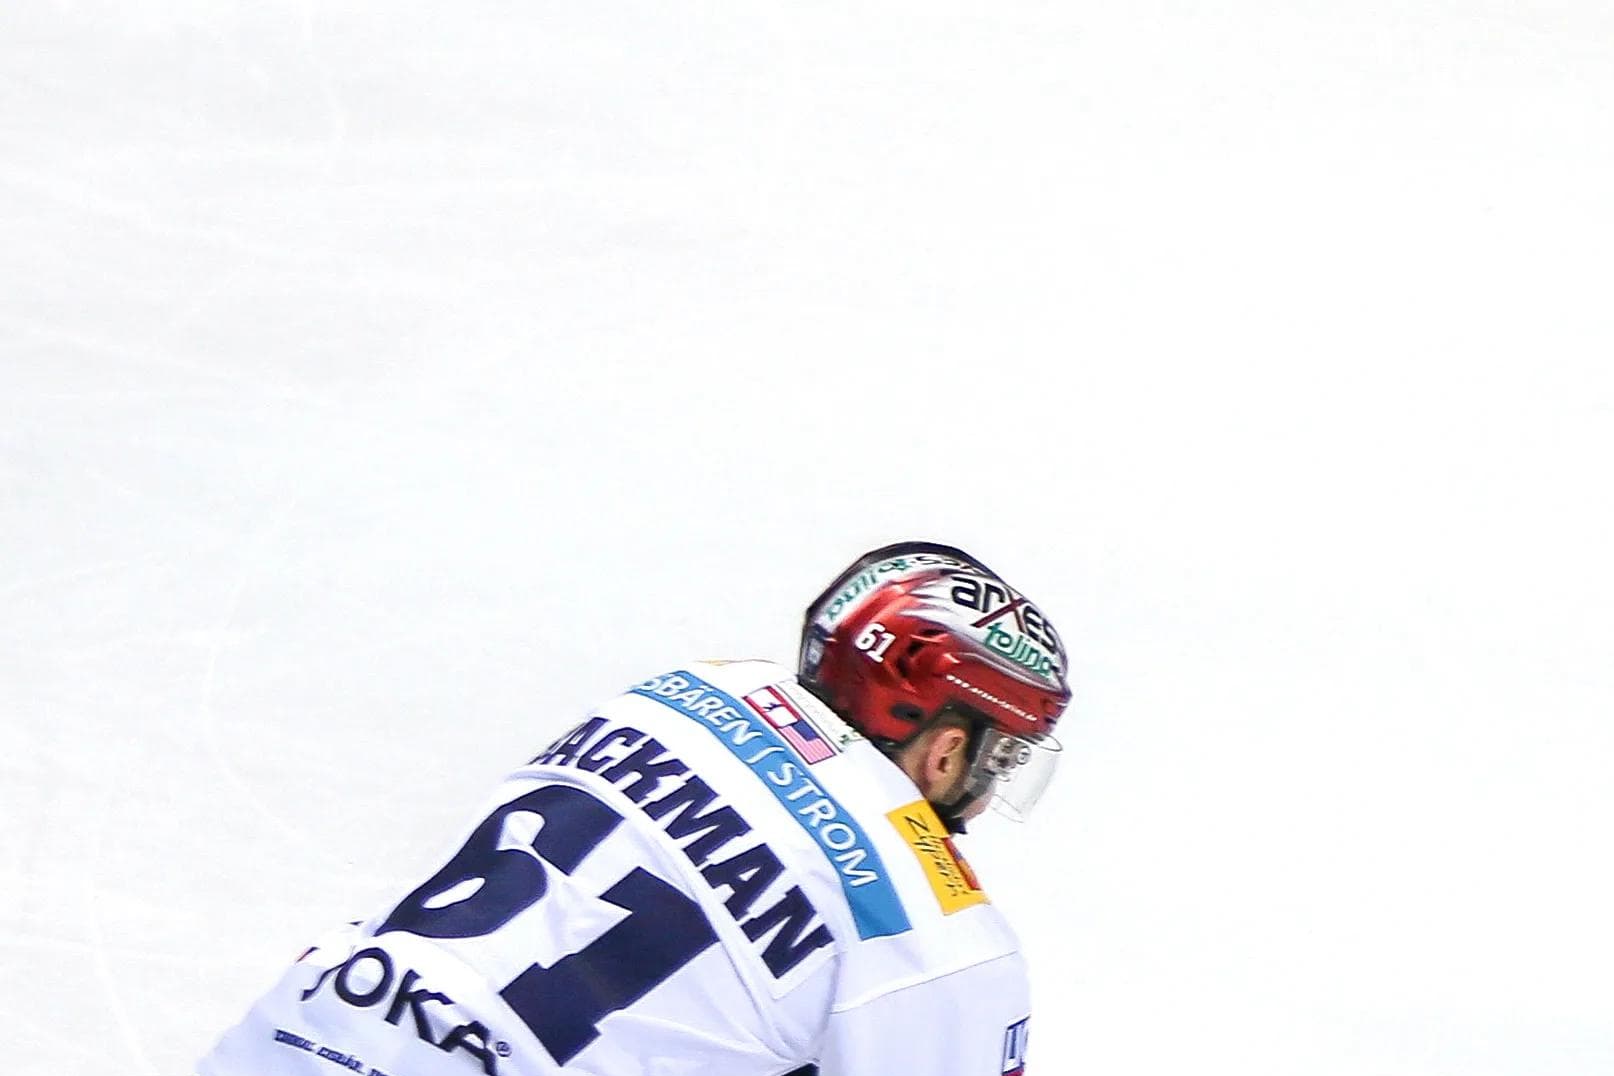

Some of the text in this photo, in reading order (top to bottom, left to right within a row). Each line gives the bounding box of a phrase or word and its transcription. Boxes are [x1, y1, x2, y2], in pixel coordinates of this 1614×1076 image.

[854, 622, 897, 664] 61
[528, 717, 834, 981] ACKMAN
[767, 761, 879, 888] STROM
[373, 784, 718, 1067] 61
